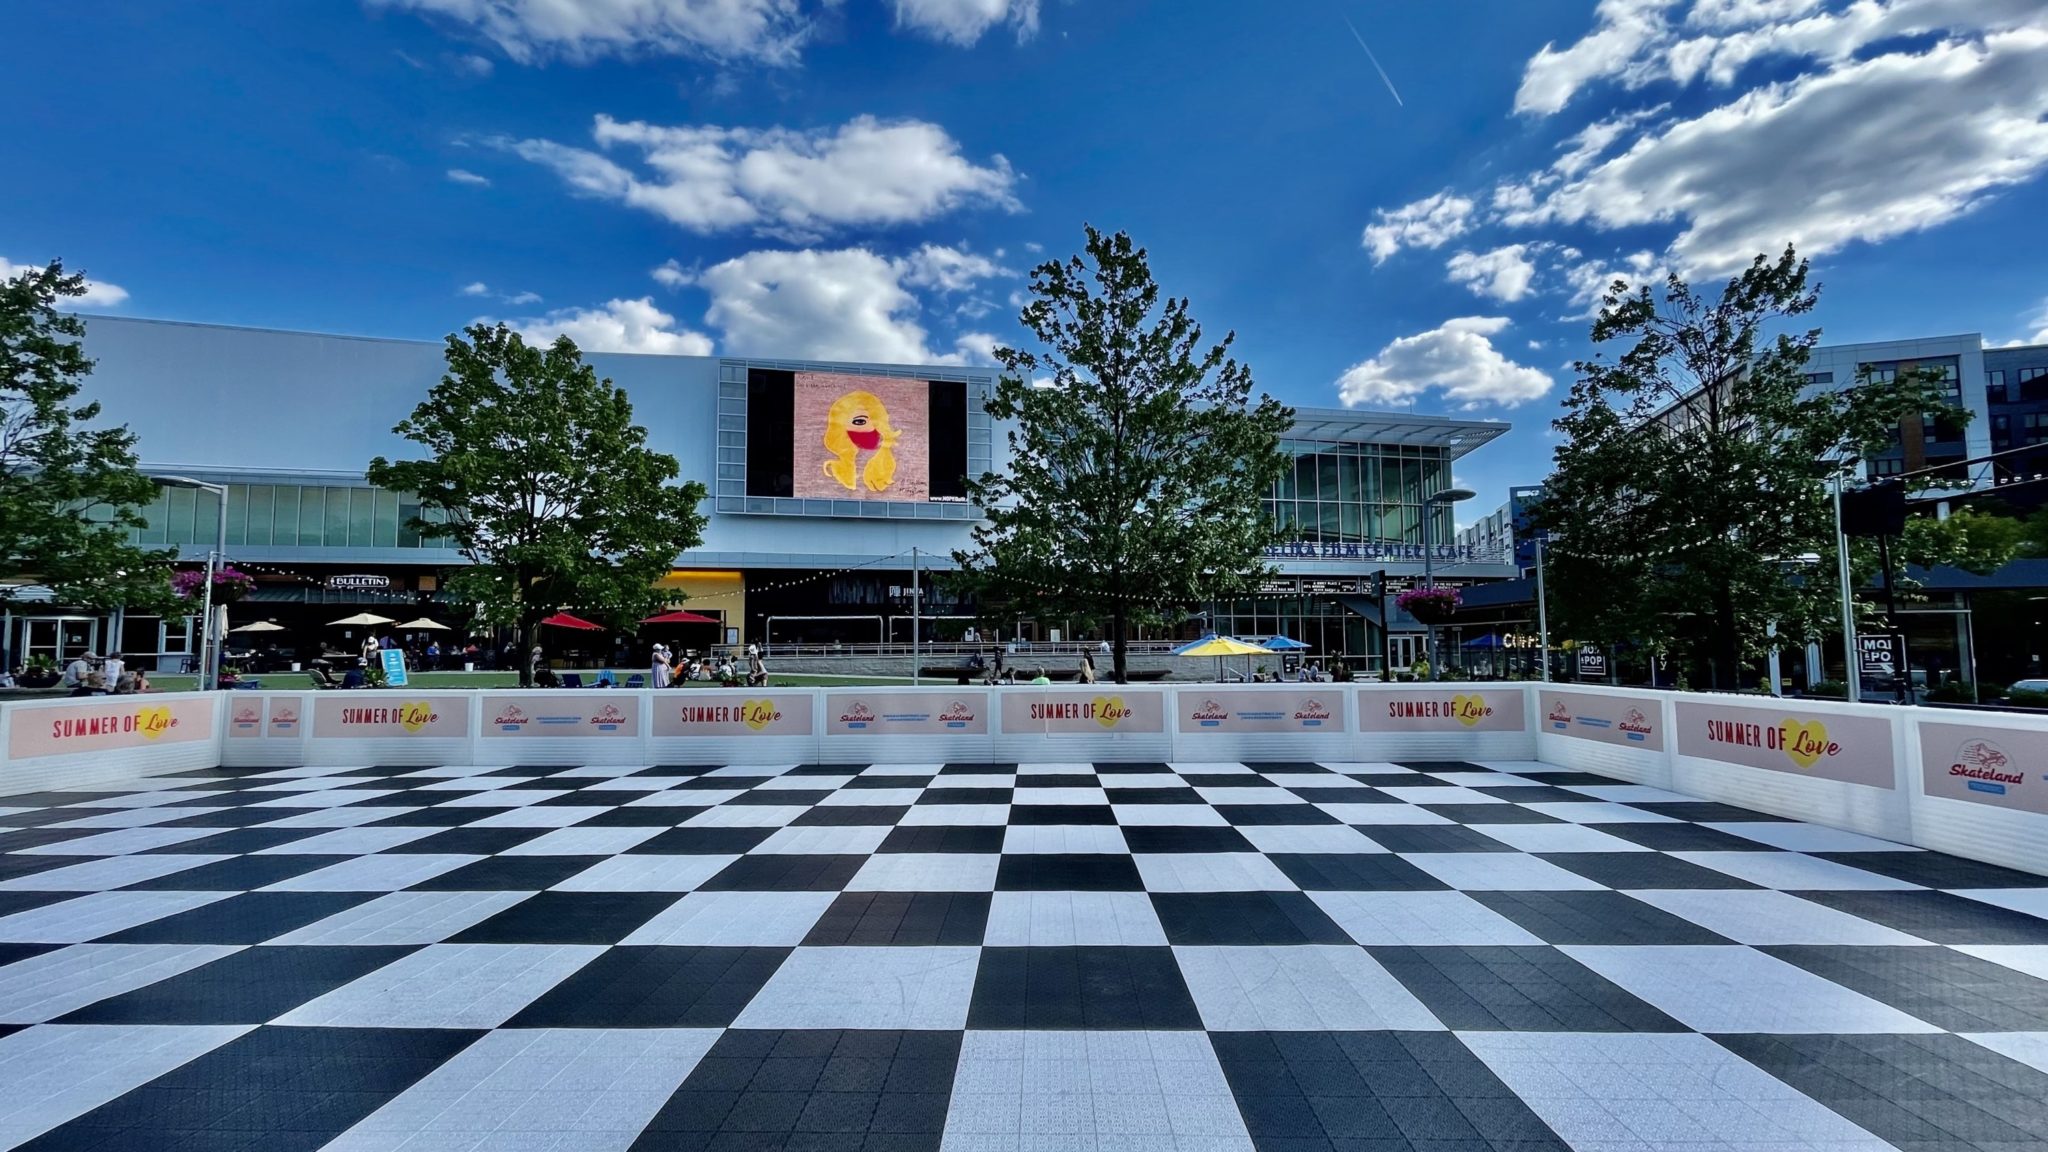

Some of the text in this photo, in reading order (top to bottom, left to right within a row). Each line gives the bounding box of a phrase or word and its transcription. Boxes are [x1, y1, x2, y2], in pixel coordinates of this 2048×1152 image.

[336, 577, 384, 586] BULLETIN
[1863, 639, 1892, 650] MO
[1871, 651, 1892, 662] PO
[342, 708, 439, 725] SUMMER OF Love
[681, 706, 783, 724] SUMMER OF Love
[1030, 702, 1133, 721] SUMMER OF Love
[1389, 701, 1494, 719] SUMMER OF Love
[52, 713, 178, 738] SUMMER OF Love
[1707, 719, 1842, 757] SUMMER OF Love
[1948, 763, 2025, 784] Skateland
